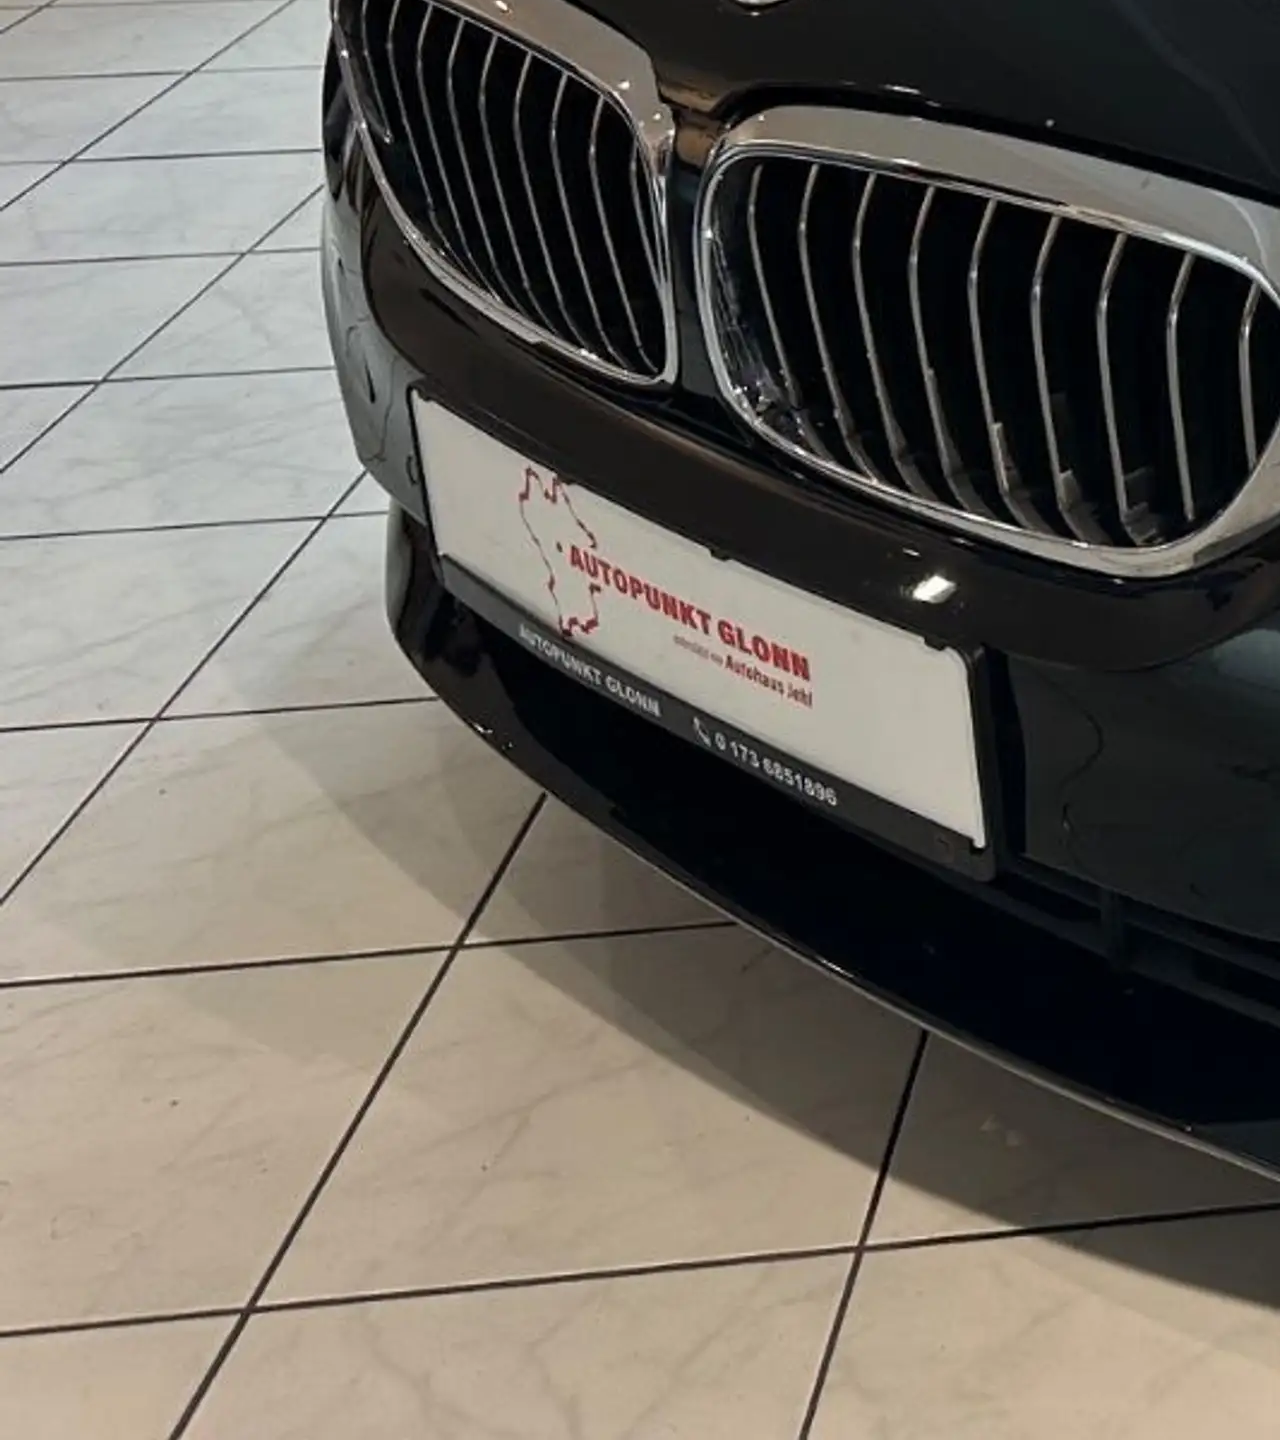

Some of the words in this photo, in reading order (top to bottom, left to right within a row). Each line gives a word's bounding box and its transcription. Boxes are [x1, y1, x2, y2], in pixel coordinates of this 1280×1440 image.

[569, 544, 712, 636] AUTOPUNKT
[717, 619, 811, 682] GLONN
[518, 623, 602, 686] AUTOPUNKT
[605, 674, 662, 717] GLONN
[724, 654, 785, 697] Autohaus
[715, 731, 727, 752] 0
[730, 737, 760, 769] 173
